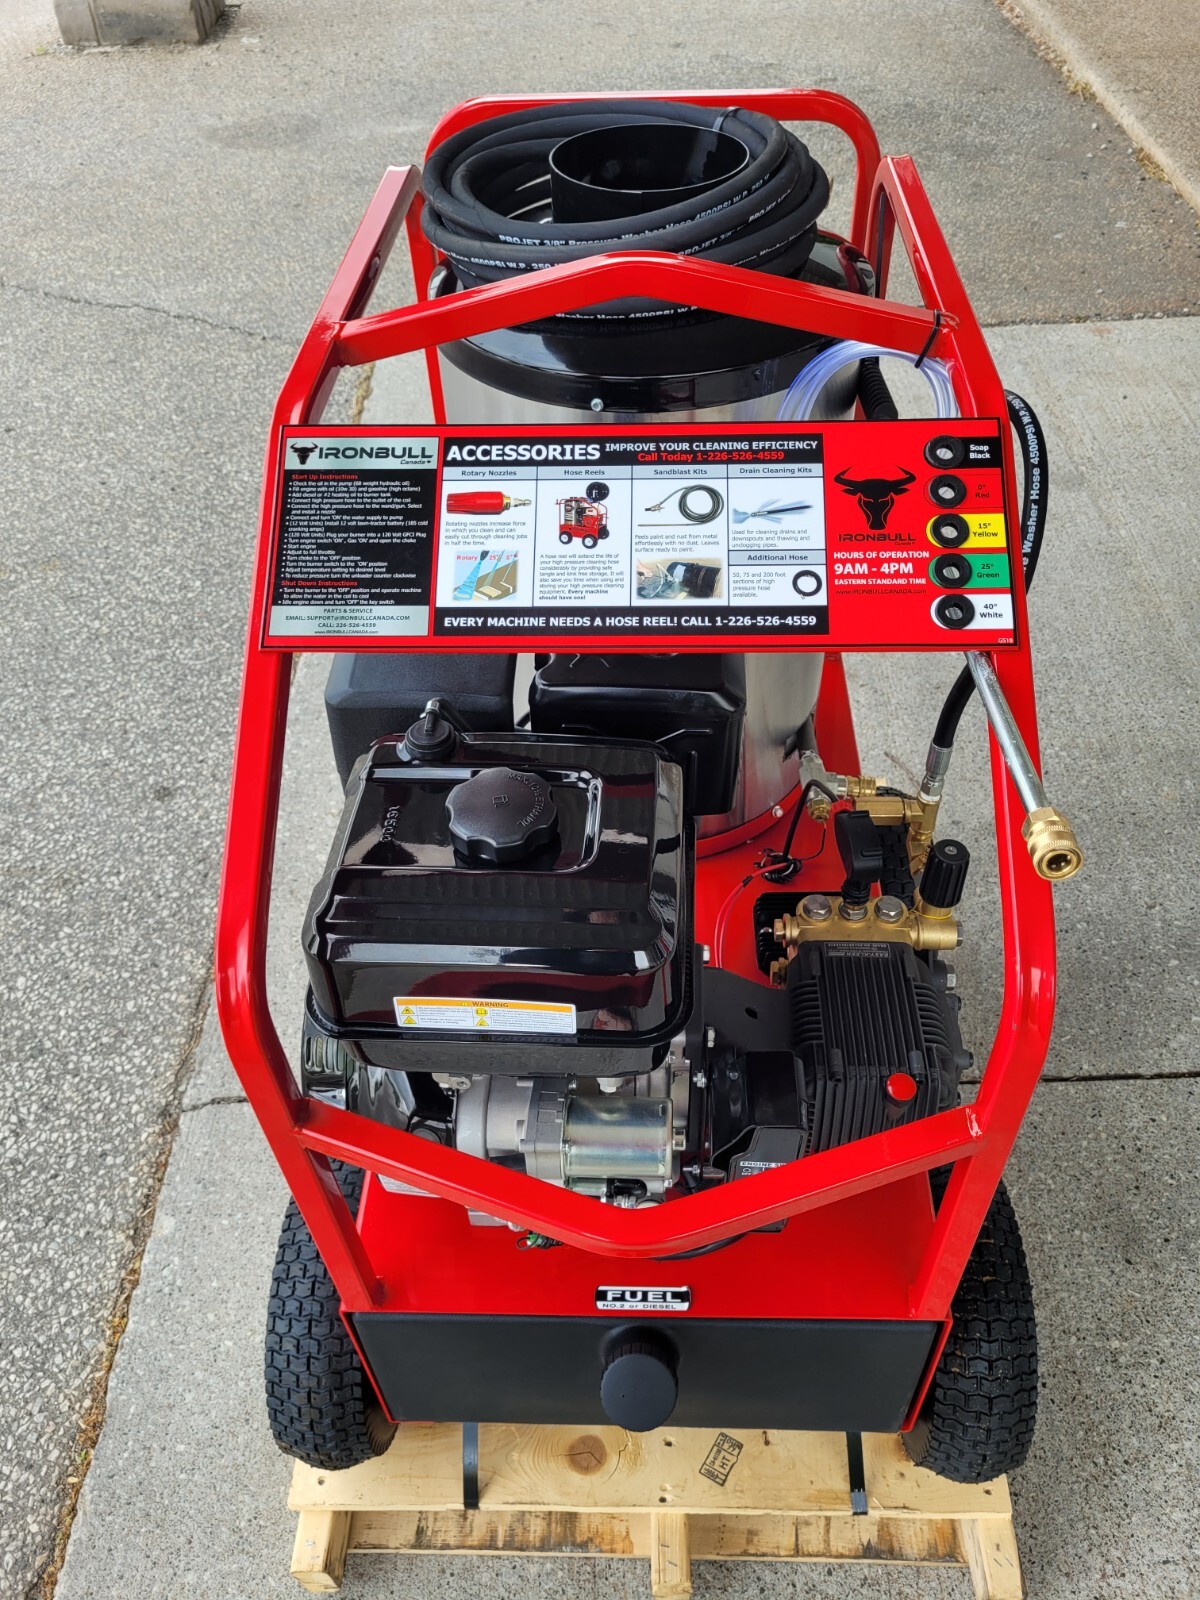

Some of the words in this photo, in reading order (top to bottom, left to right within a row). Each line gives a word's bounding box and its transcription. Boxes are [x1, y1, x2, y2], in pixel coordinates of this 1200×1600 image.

[499, 235, 540, 246] PROJET
[1025, 424, 1040, 464] 4500PSI
[318, 447, 434, 459] IRONBULL
[447, 444, 601, 461] ACCESSORIES
[605, 443, 656, 452] IMPROVE
[659, 442, 690, 451] YOUR
[692, 442, 749, 450] CLEANING
[752, 441, 818, 450] EFFICIENCY
[661, 453, 693, 462] Today
[696, 452, 784, 460] 1-226-526-4559
[1030, 467, 1040, 499] Hose
[1022, 503, 1039, 554] Washer
[839, 533, 916, 542] IRONBULL
[834, 563, 868, 574] 9AM
[880, 563, 913, 574] 4PM
[444, 617, 484, 627] EVERY
[487, 617, 546, 627] MACHINE
[550, 617, 590, 626] NEEDS
[594, 617, 603, 626] A
[606, 617, 640, 626] HOSE
[643, 616, 677, 626] REEL!
[681, 616, 712, 626] CALL
[716, 616, 816, 626] 1-226-526-4559
[607, 1291, 681, 1302] FUEL
[719, 1455, 731, 1470] HT
